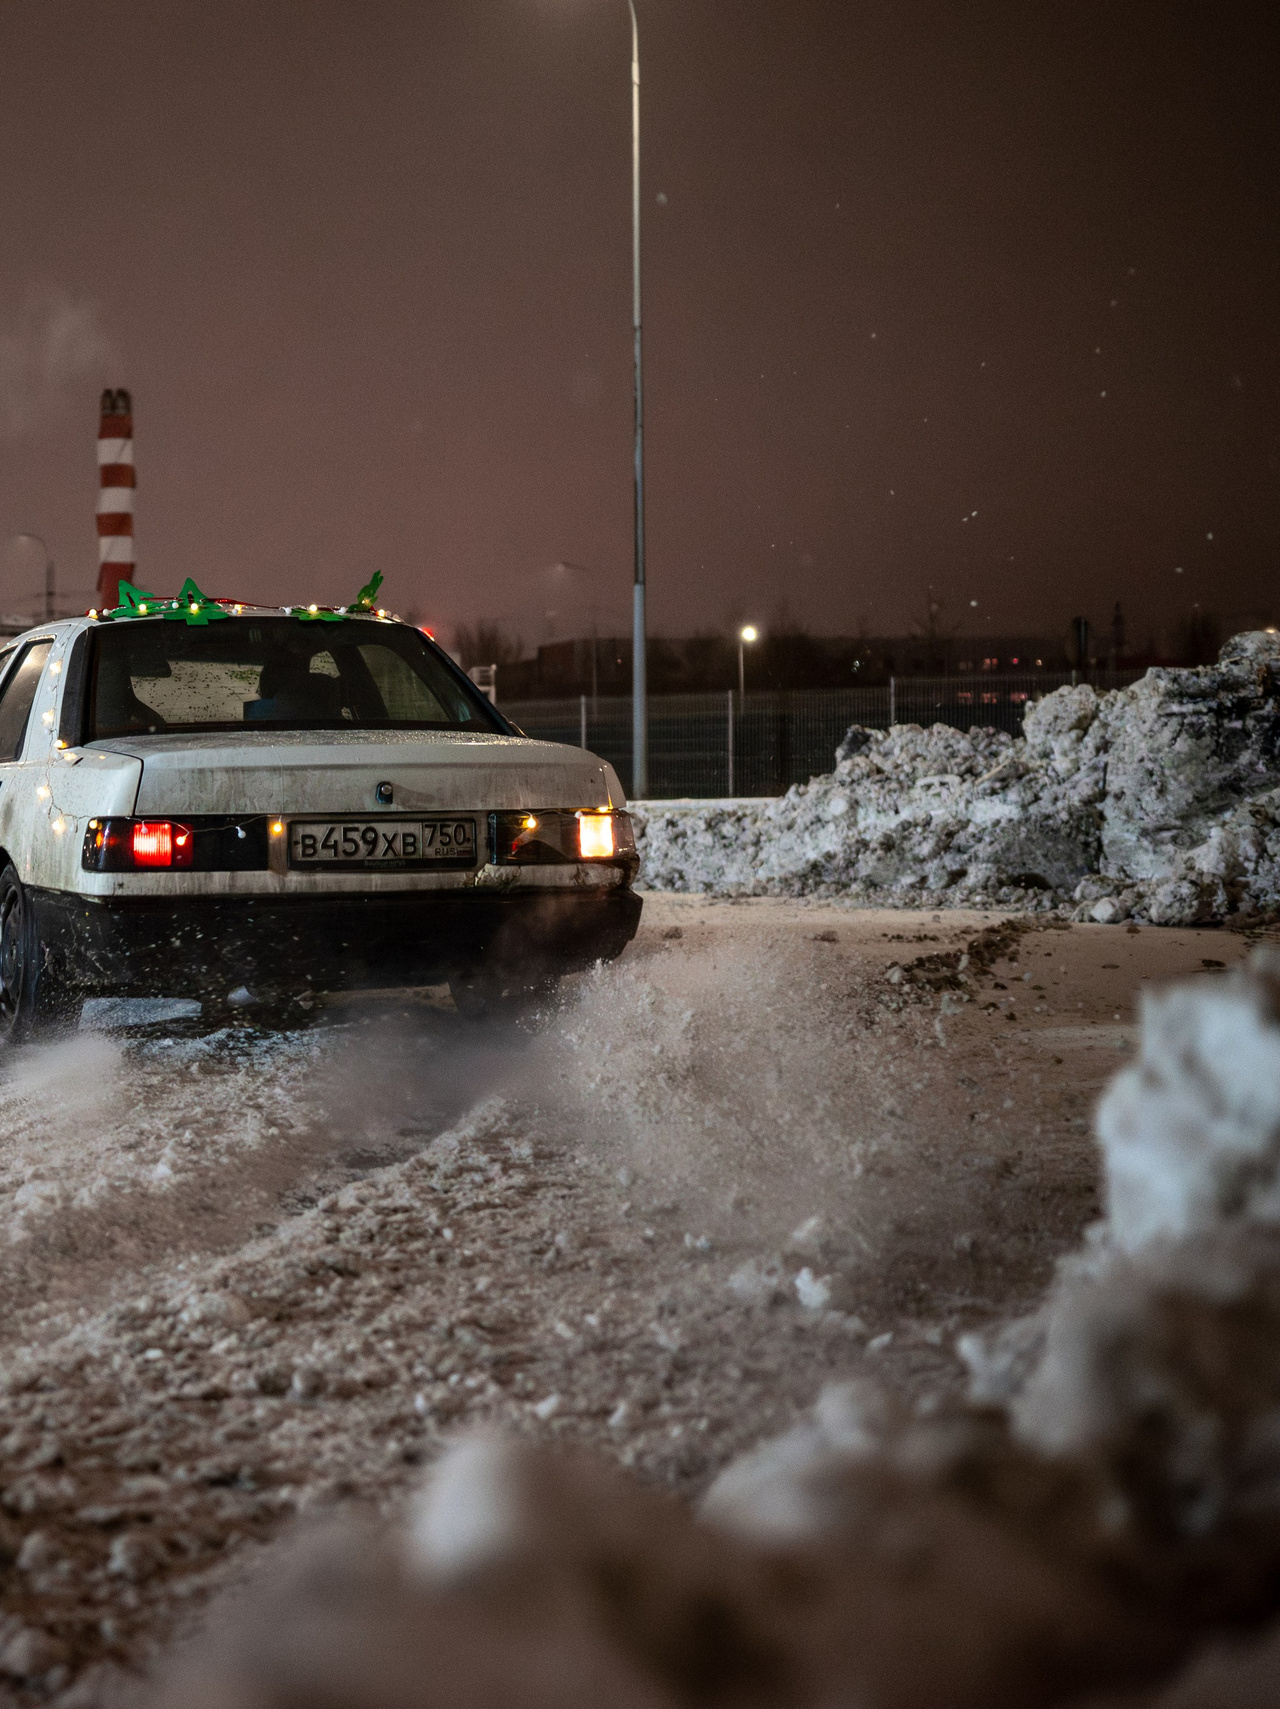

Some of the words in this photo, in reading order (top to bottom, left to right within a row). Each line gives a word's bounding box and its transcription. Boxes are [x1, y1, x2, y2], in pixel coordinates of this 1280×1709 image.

[301, 826, 417, 858] В459ХВ
[424, 823, 467, 847] 750
[434, 847, 457, 856] RUS
